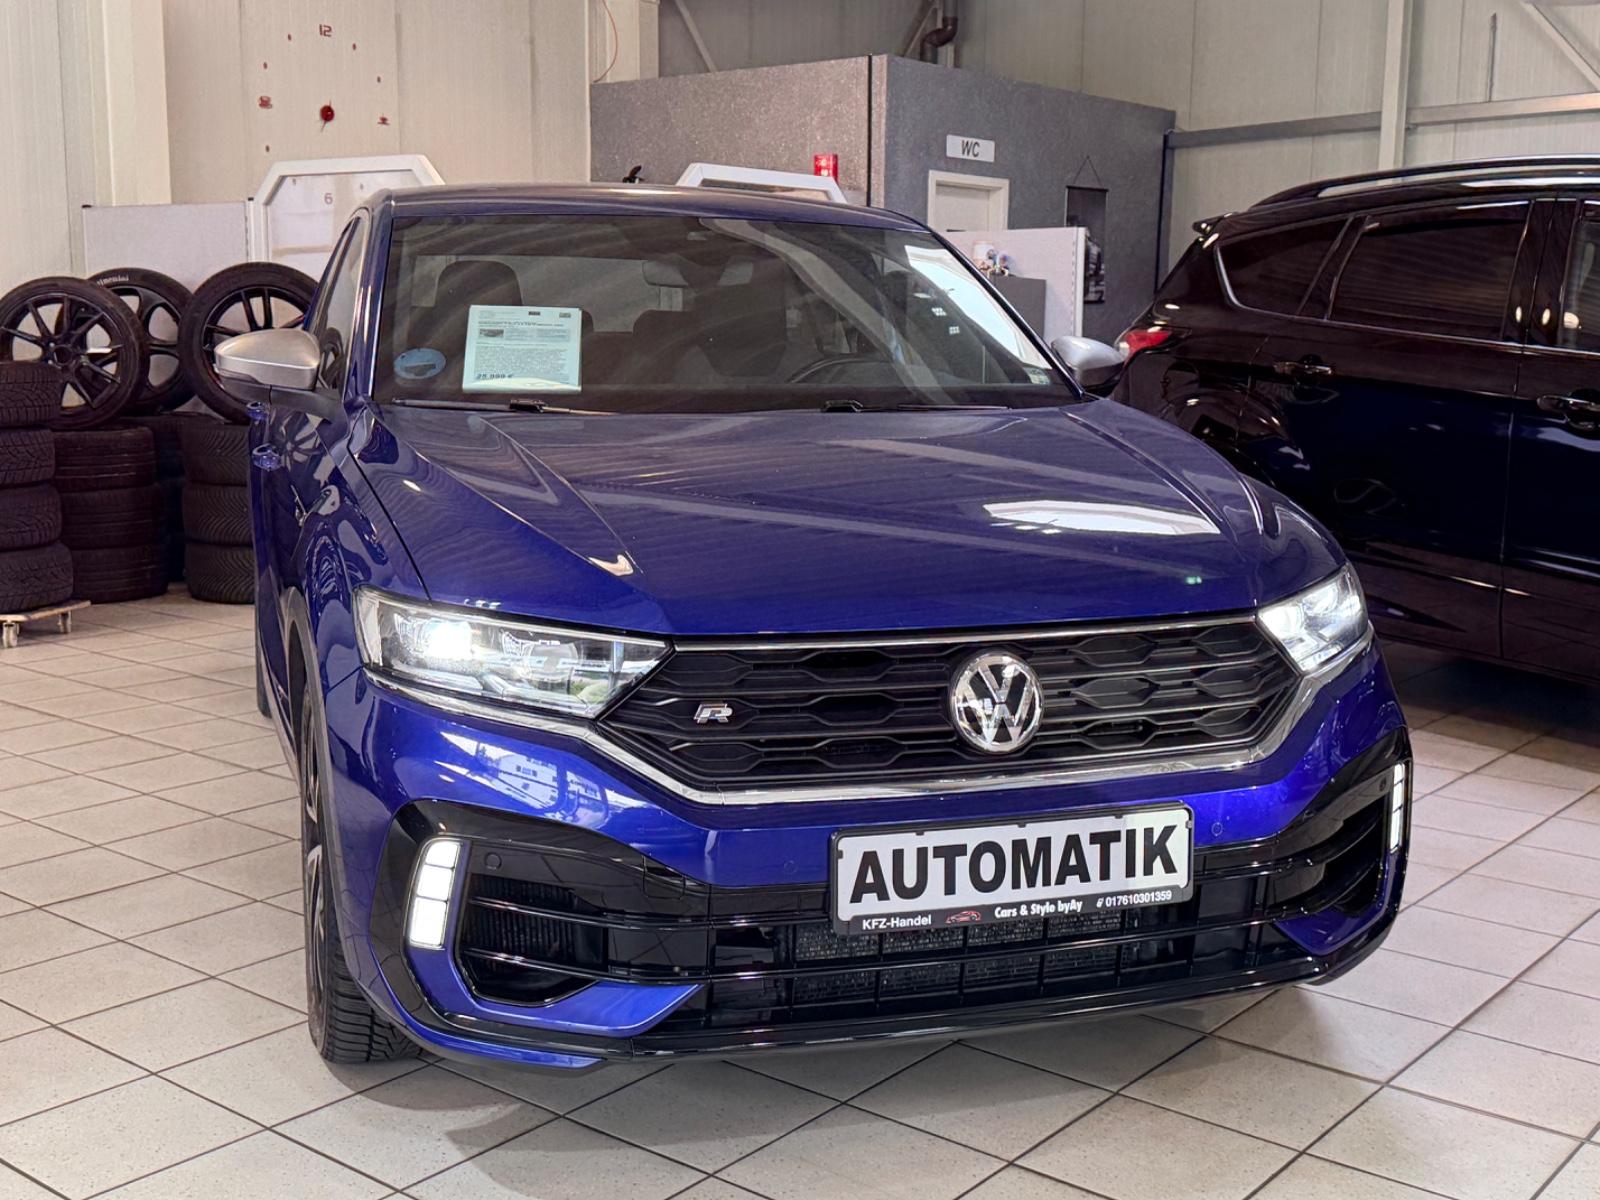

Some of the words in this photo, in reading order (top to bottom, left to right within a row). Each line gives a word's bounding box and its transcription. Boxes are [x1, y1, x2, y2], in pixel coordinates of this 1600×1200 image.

[319, 24, 332, 37] 12
[961, 140, 980, 158] WC
[693, 703, 733, 724] R
[849, 824, 1178, 904] AUTOMATIK
[1105, 889, 1173, 908] 017610301359
[994, 906, 1018, 918] Cars
[1019, 904, 1029, 916] &
[1030, 902, 1056, 916] Style
[862, 914, 932, 930] KFZ-Handel
